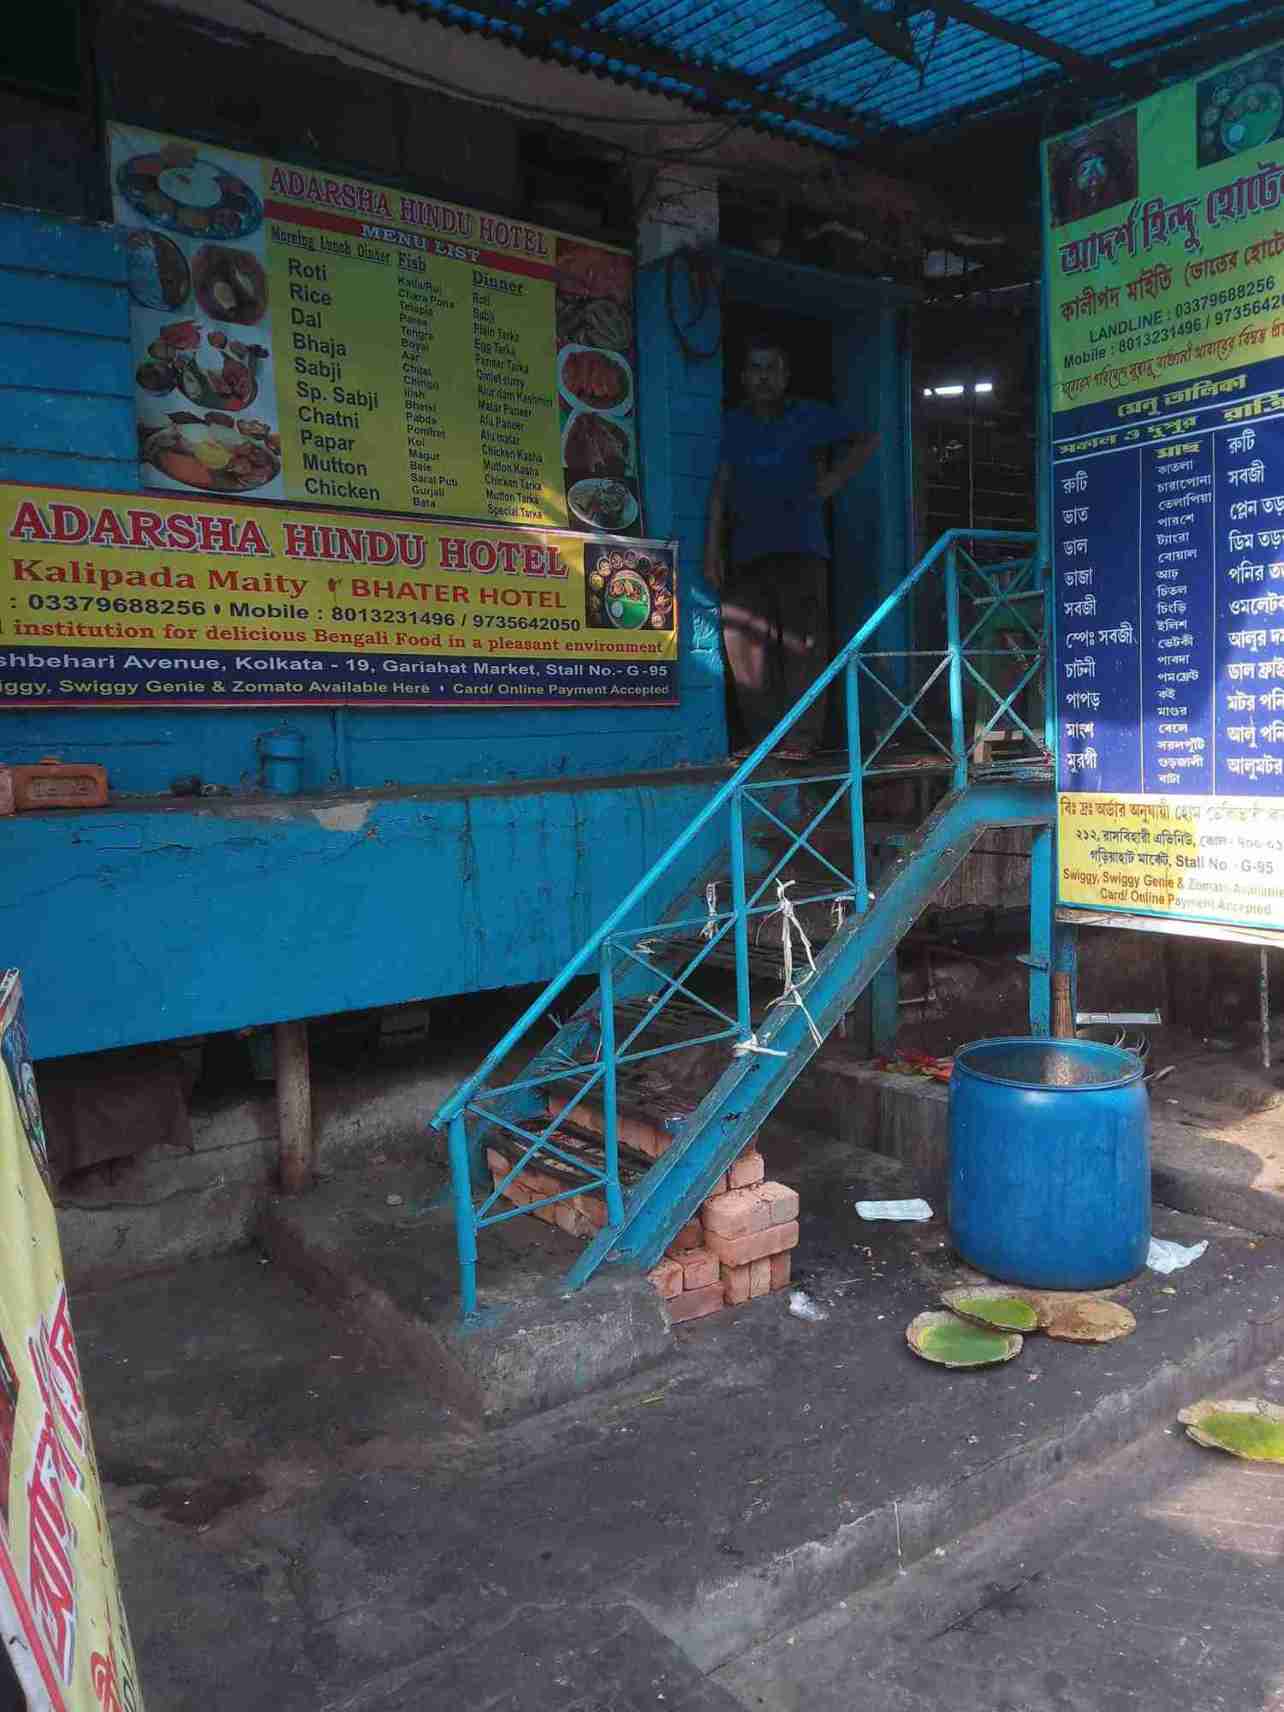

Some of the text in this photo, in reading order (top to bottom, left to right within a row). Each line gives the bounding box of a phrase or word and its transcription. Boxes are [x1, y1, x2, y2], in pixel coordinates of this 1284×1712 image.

[271, 167, 549, 256] ADARSHA HINDU HOTEL
[1059, 161, 1284, 275] আদর্শ হিন্দু হোটে
[360, 223, 481, 262] MENU LIST
[288, 257, 328, 281] Roti
[289, 282, 332, 306] Rice
[472, 269, 524, 295] Dinner
[1126, 263, 1173, 301] মাইতি
[291, 307, 322, 329] Dal
[1089, 275, 1275, 344] LANDLINE 03379688256
[293, 332, 347, 359] Bhaja
[1064, 346, 1106, 369] Mobile
[1119, 317, 1202, 353] 8013231496
[294, 356, 342, 383] Sabji
[296, 380, 379, 412] Sp. Sabji
[1117, 398, 1159, 418] মেনু
[1164, 374, 1248, 407] তালিকা
[298, 405, 360, 430] Chatni
[300, 429, 356, 451] Papar
[1228, 429, 1256, 455] রুটি
[303, 452, 369, 477] Mutton
[409, 448, 440, 461] Magur
[1061, 470, 1088, 494] রুটি
[1228, 459, 1265, 488] সবজী
[304, 477, 381, 501] Chicken
[1062, 507, 1089, 525] ভাত
[1230, 500, 1257, 521] প্লেন
[10, 501, 569, 579] ADARSHA HINDU HOTEL
[1063, 538, 1088, 556] ডাল
[1229, 529, 1255, 552] ডিম
[11, 556, 568, 609] Kalipada Maity BHATER HOTEL
[1064, 567, 1095, 587] ভাজা
[1228, 560, 1265, 585] পনির
[28, 592, 207, 617] 03379688256
[229, 601, 310, 621] Mobile
[331, 605, 455, 628] 8013231496
[472, 613, 581, 633] 9735642050
[1064, 594, 1096, 617] সবজী
[14, 618, 156, 642] institution
[164, 623, 197, 642] for
[205, 624, 307, 644] delicious
[313, 628, 388, 649] Bengali
[395, 630, 442, 649] Food
[449, 634, 466, 650] in
[472, 637, 483, 651] a
[488, 635, 561, 654] pleasant
[564, 638, 664, 655] environment
[1098, 622, 1134, 645] সবজী
[1228, 630, 1266, 652] আলুর
[0, 652, 115, 671] shbehari
[123, 654, 228, 674] Avenue,
[235, 655, 324, 673] Kolkata
[382, 659, 468, 675] Gariahat
[473, 662, 541, 679] Market,
[545, 663, 584, 677] Stall
[1064, 655, 1096, 679] চাটনী
[1228, 661, 1257, 681] ডাল
[60, 680, 139, 697] Swiggy
[145, 680, 206, 694] Genie
[212, 680, 226, 694] &
[231, 681, 305, 695] Zomato
[308, 681, 387, 696] Available
[392, 683, 431, 695] Here
[453, 682, 494, 696] Card/
[497, 683, 546, 697] Online
[548, 682, 608, 698] Payment
[610, 684, 670, 698] Accepted
[1066, 691, 1101, 710] পাপড়
[1227, 724, 1257, 748] আলু
[1175, 854, 1205, 868] Stall
[1063, 868, 1100, 886] Swiggy,
[1103, 871, 1140, 888] Swiggy
[1143, 873, 1175, 889] Genie
[1131, 889, 1165, 905] Online
